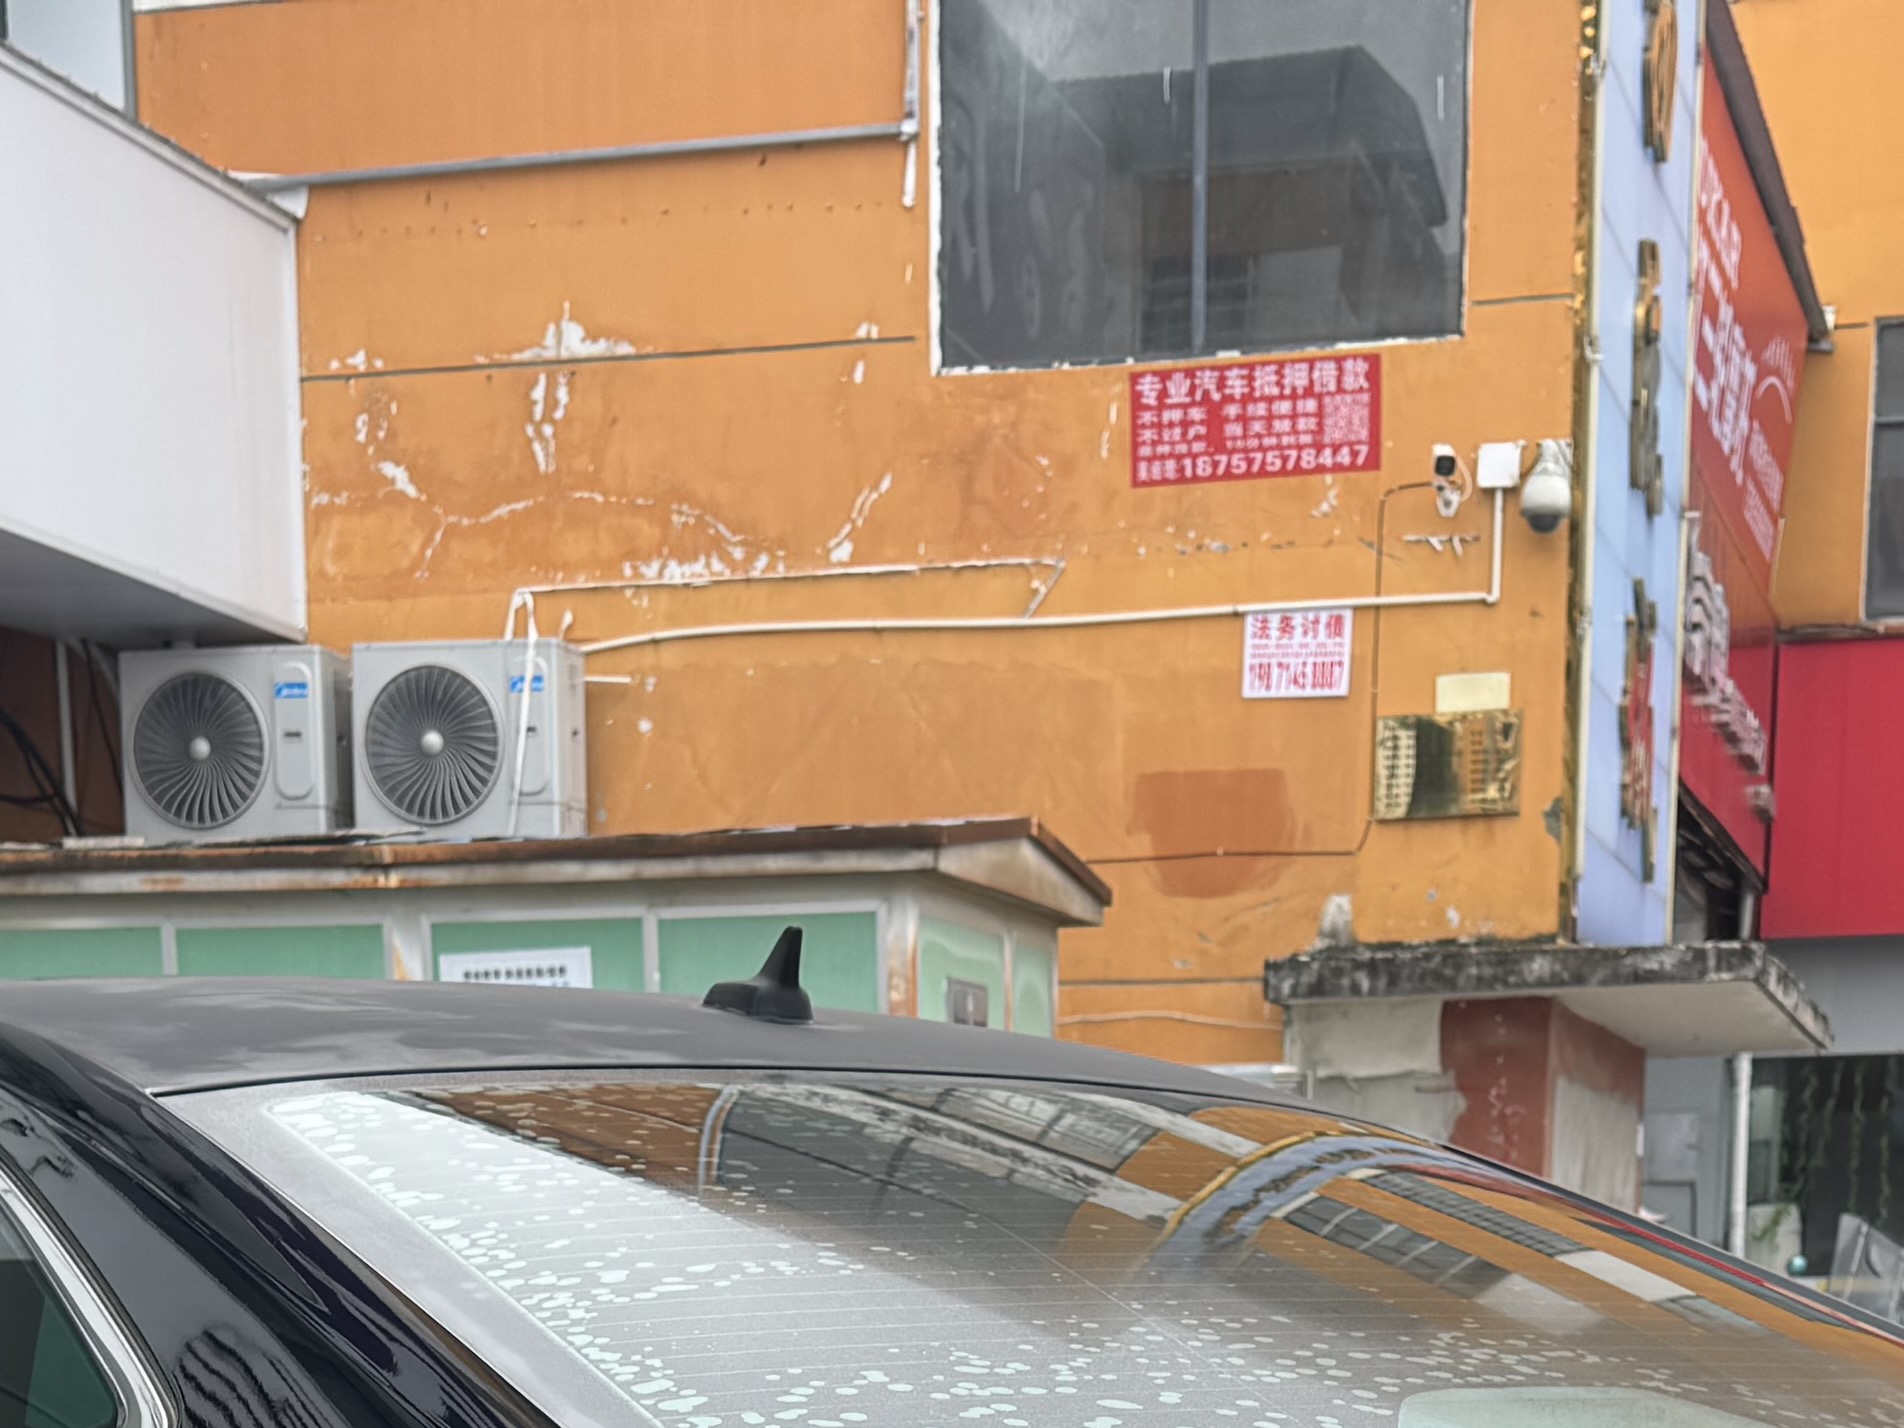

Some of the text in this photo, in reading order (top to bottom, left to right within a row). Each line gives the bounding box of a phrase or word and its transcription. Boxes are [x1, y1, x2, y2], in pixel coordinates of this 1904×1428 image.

[1135, 357, 1370, 406] 专业汽车抵押借款
